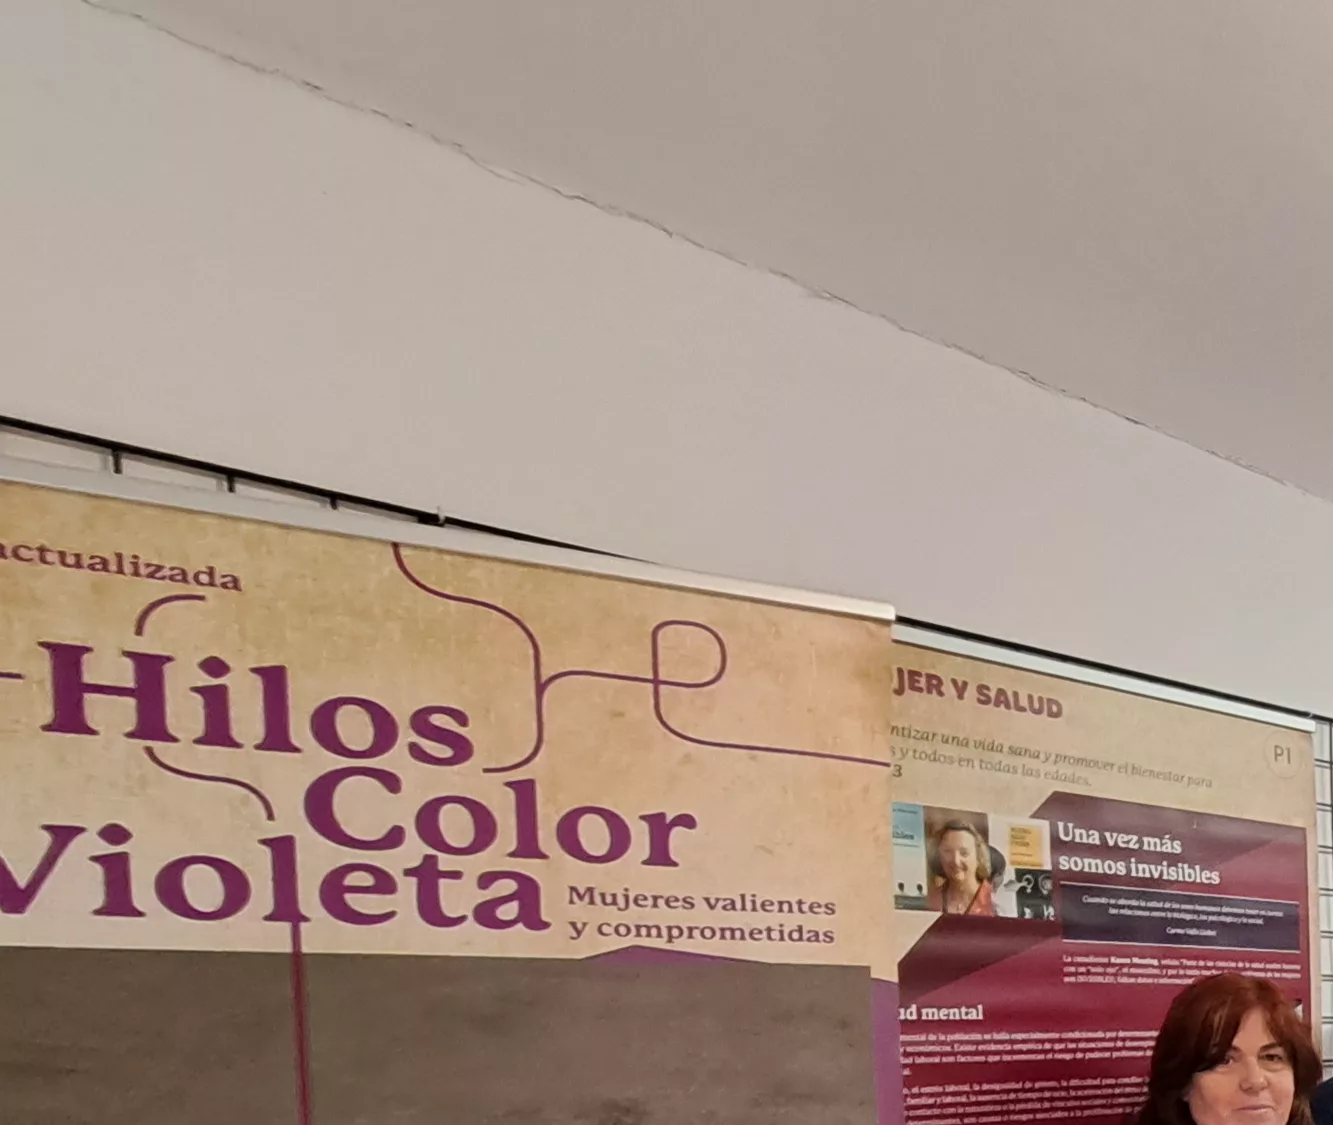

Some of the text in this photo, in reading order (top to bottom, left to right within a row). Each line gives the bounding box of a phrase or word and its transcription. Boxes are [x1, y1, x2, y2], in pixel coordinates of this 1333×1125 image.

[37, 640, 475, 767] Hilos
[950, 677, 968, 701] Y
[976, 683, 1063, 719] SALUD
[899, 747, 1093, 787] y todos en todas las edades.
[941, 733, 970, 749] una
[973, 737, 1004, 754] vida
[1008, 744, 1040, 760] sana
[1043, 751, 1052, 764] y
[1054, 754, 1115, 772] promover
[1117, 761, 1128, 775] el
[1131, 764, 1185, 784] bienestar
[1187, 776, 1213, 789] para
[1273, 744, 1292, 765] P1
[303, 766, 697, 867] Color
[1057, 821, 1182, 854] Una vez más
[0, 823, 551, 933] Violeta
[1058, 855, 1221, 885] somos invisibles
[568, 886, 836, 915] Mujeres valientes
[569, 921, 835, 944] y comprometidas
[921, 1004, 984, 1021] mental
